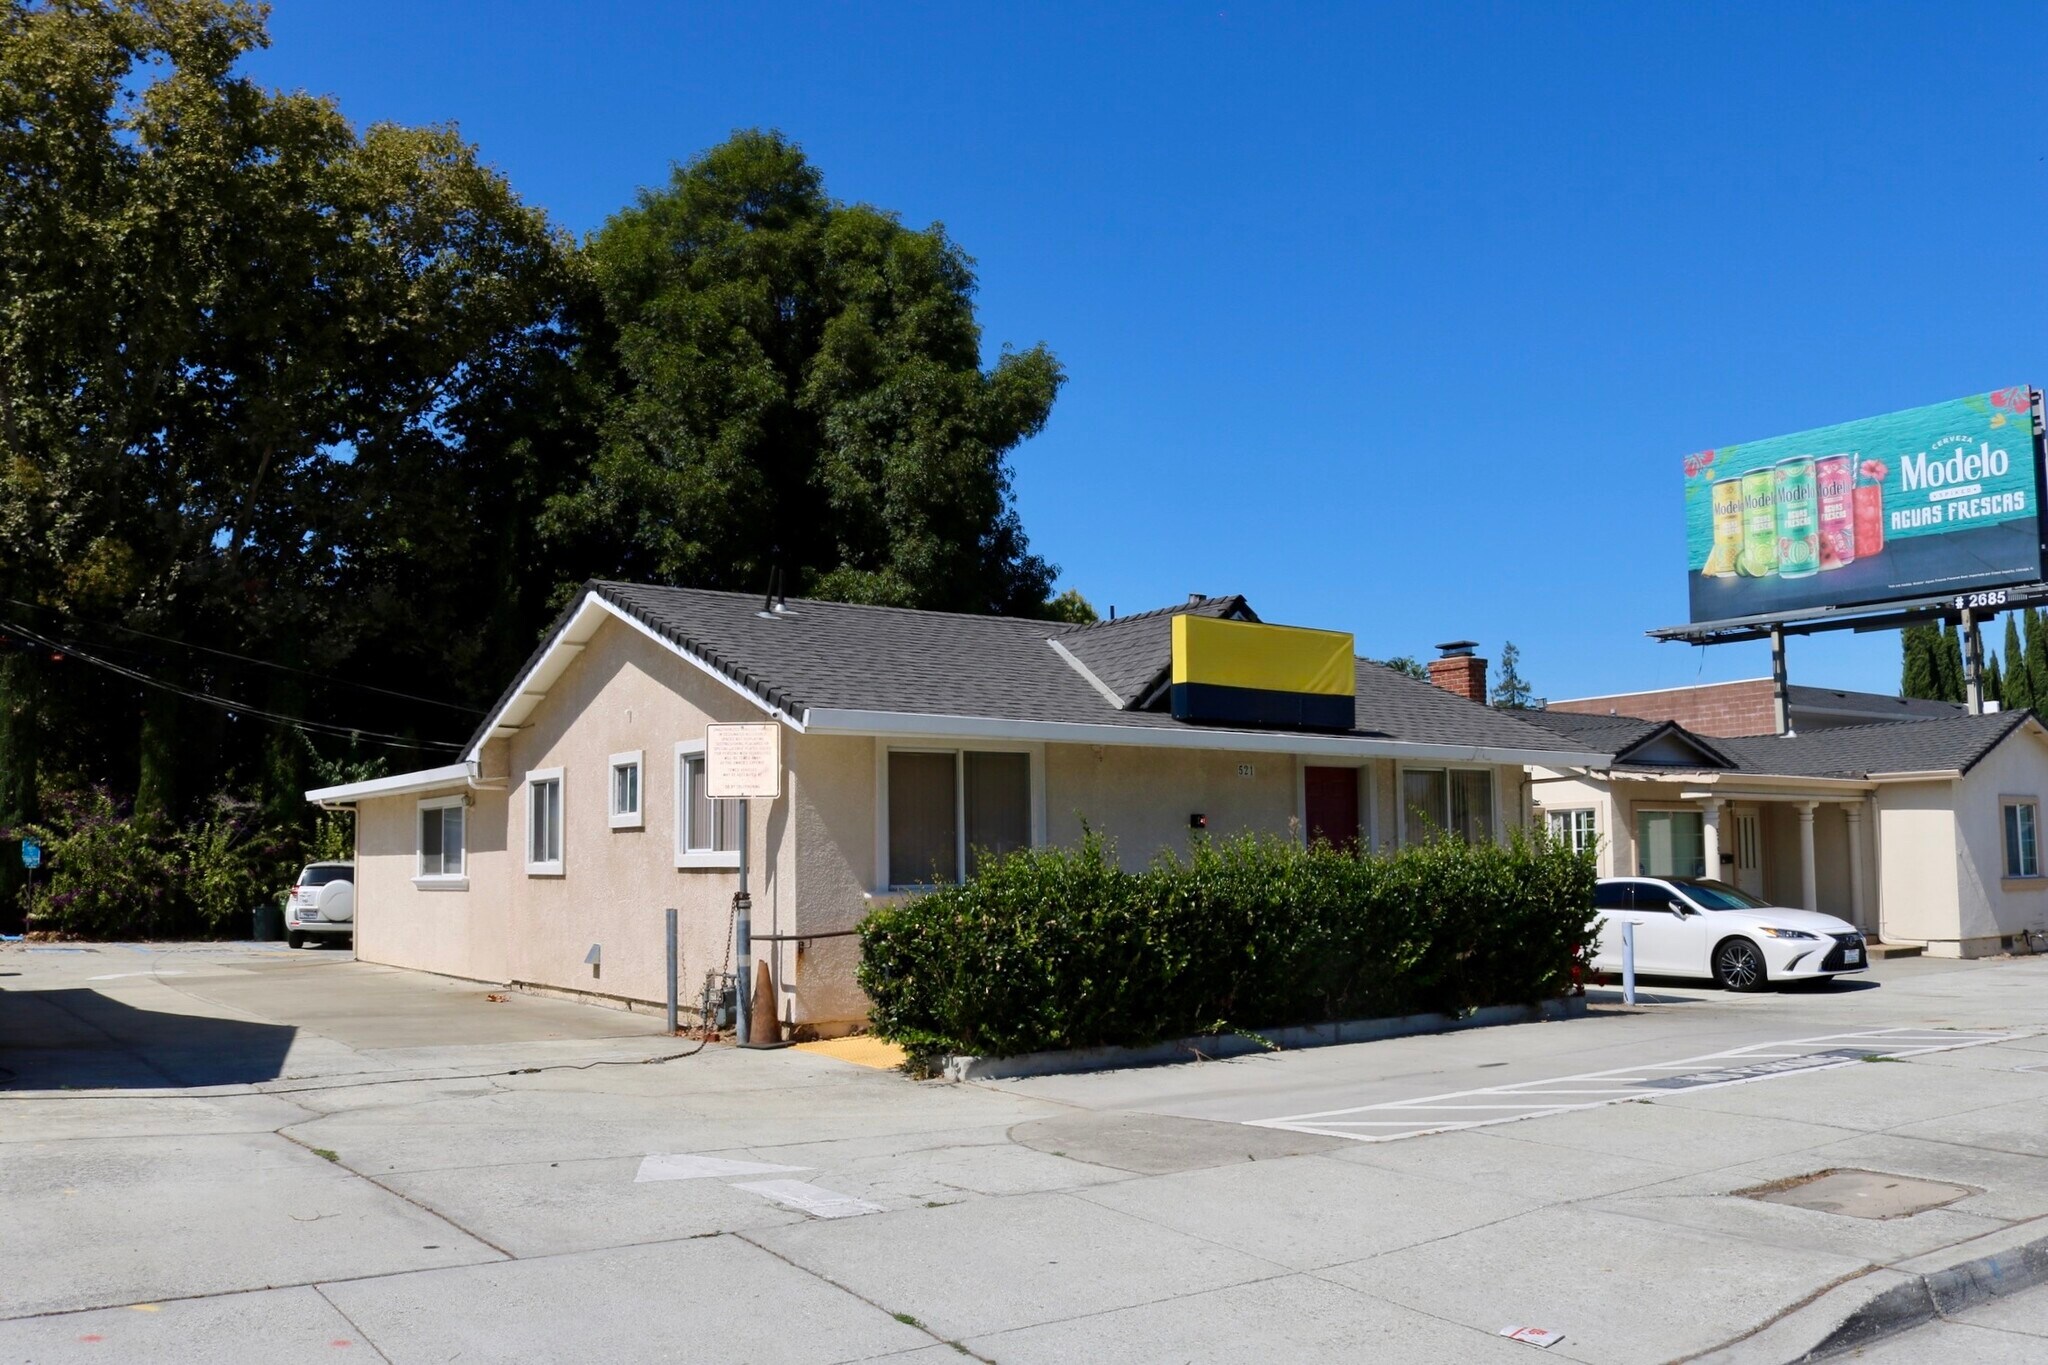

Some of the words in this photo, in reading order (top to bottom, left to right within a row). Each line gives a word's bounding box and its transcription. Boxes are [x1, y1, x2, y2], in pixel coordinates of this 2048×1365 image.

[1932, 435, 1973, 450] CERVEZA
[1900, 442, 2009, 492] Modelo
[1891, 504, 1942, 530] AGUAS
[1948, 491, 2025, 521] FRESCAS
[1954, 596, 1964, 609] #
[1969, 591, 2006, 608] 2685
[1238, 765, 1253, 776] 521
